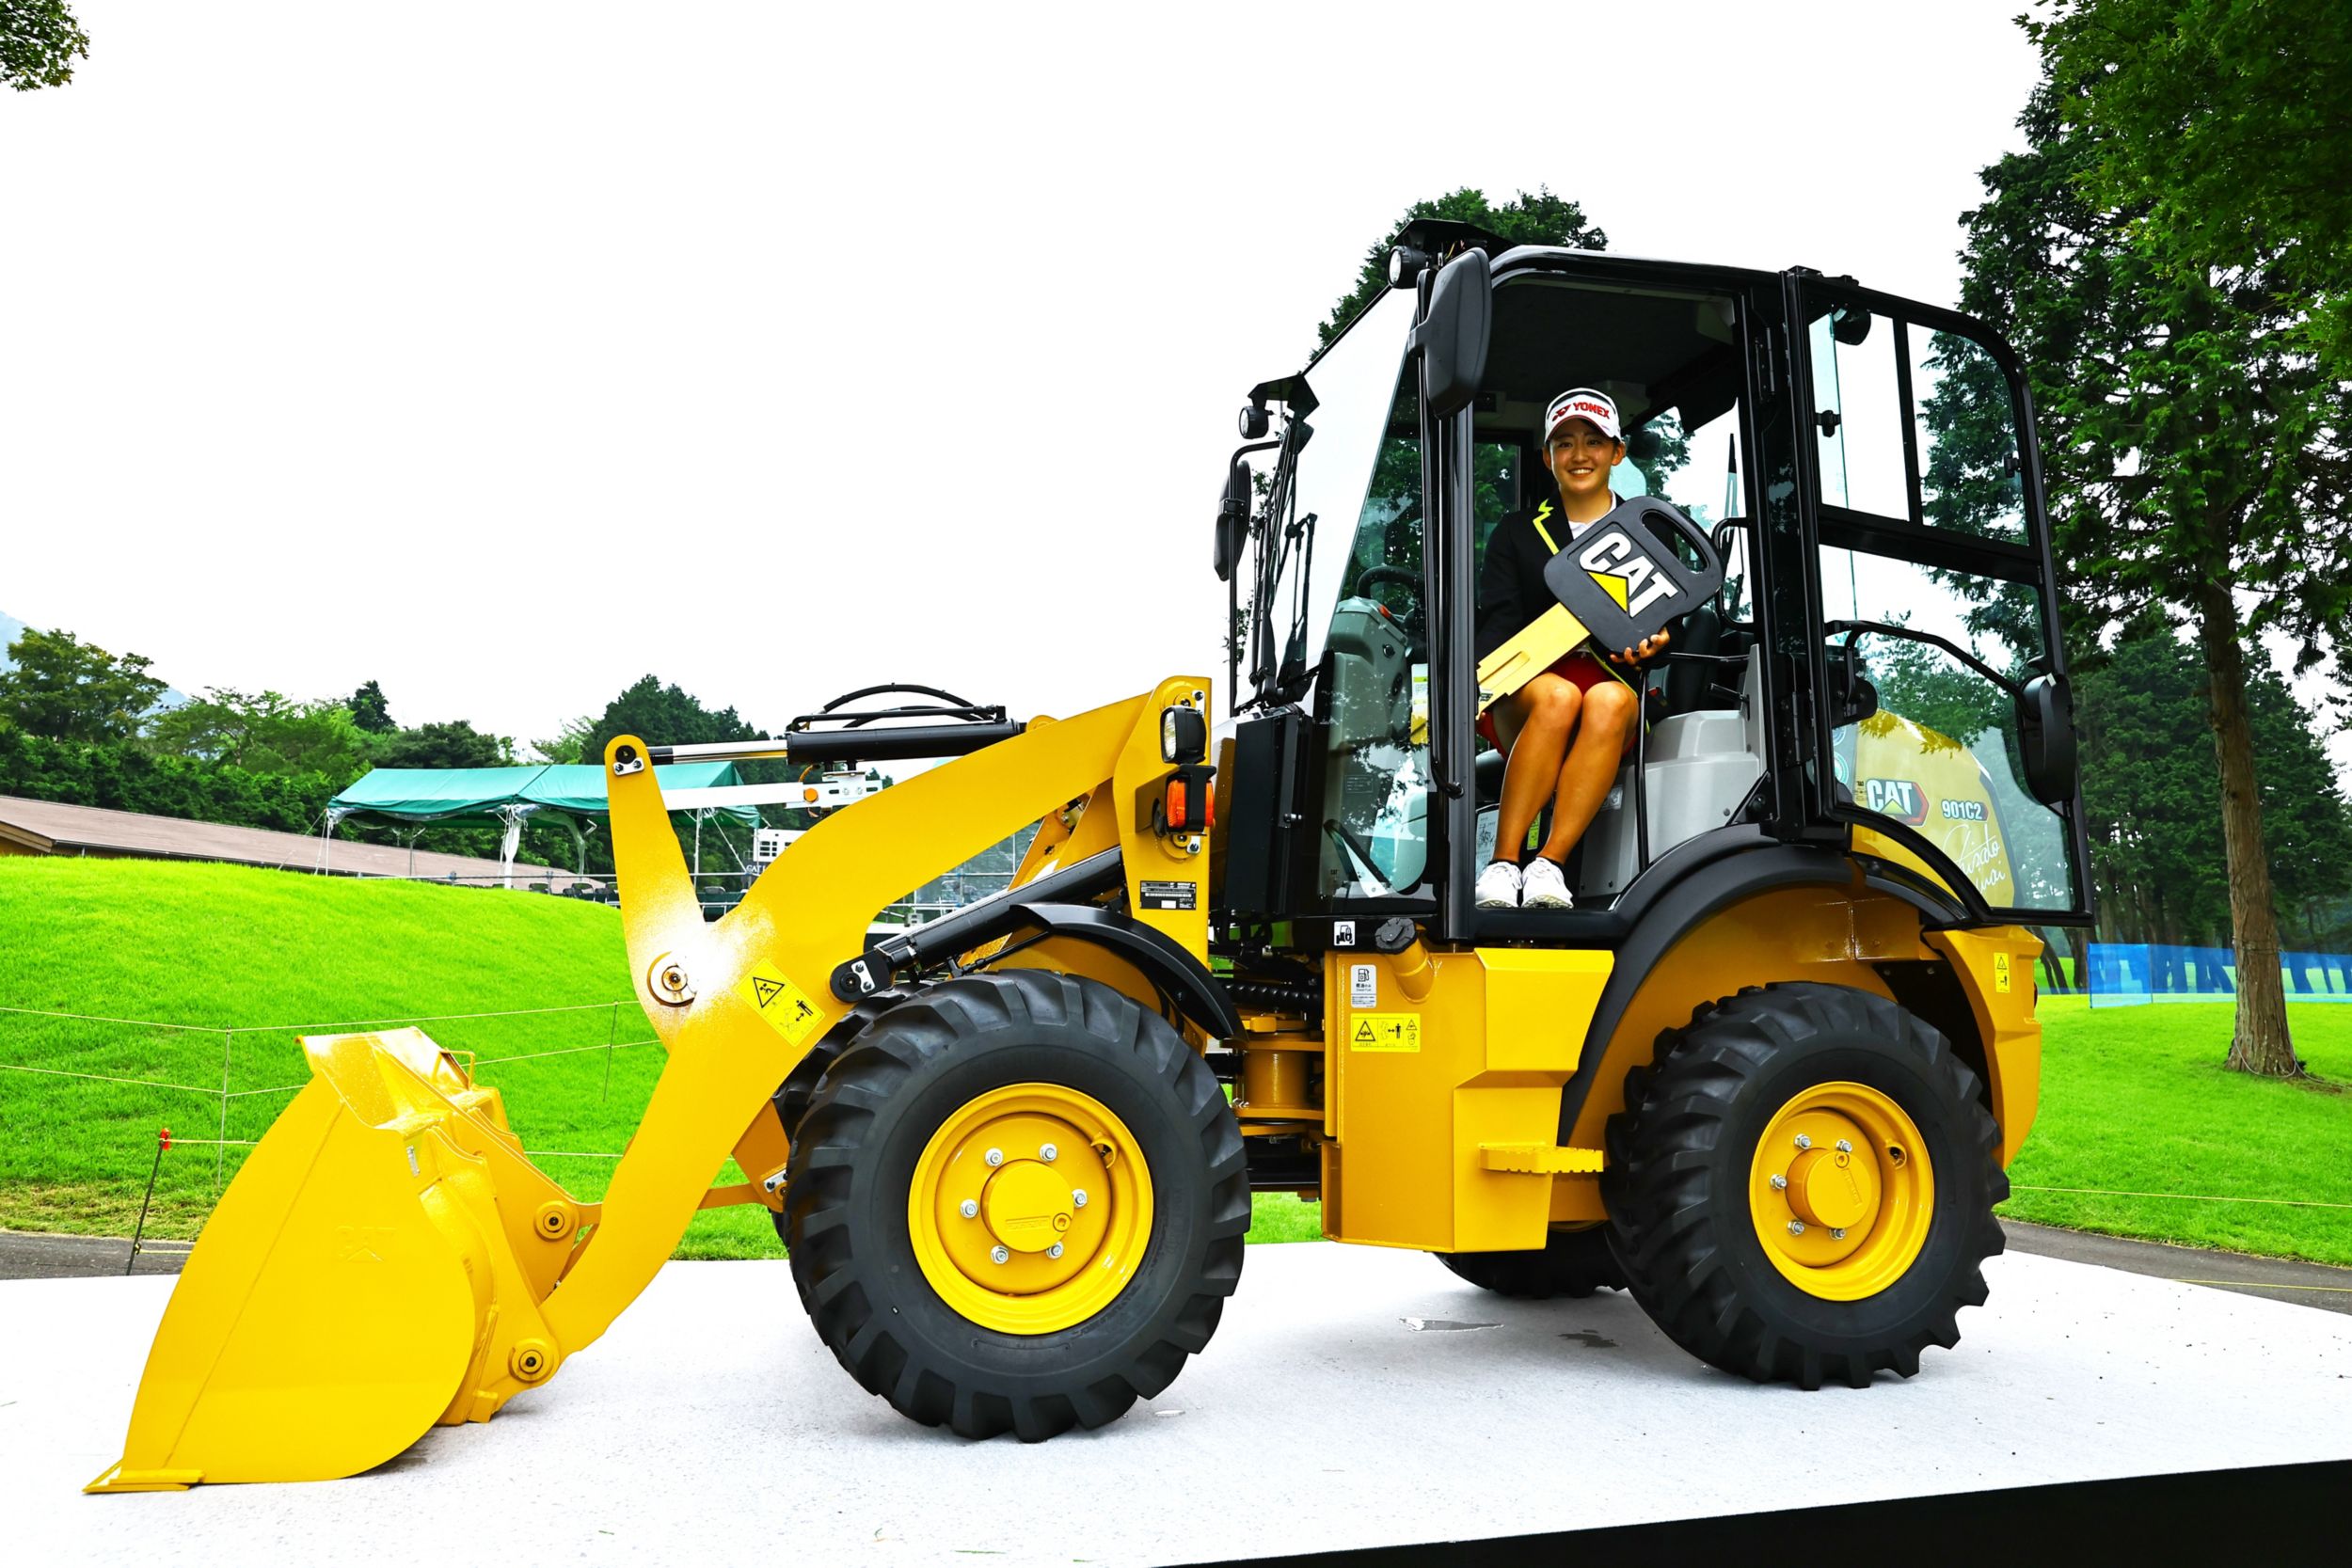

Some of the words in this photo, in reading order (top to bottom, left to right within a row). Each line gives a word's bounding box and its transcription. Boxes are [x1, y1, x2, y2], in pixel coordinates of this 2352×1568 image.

[1573, 402, 1610, 420] YONEX
[1579, 532, 1678, 619] CAT
[1866, 779, 1913, 816] CAT
[1942, 800, 1982, 820] 901C2
